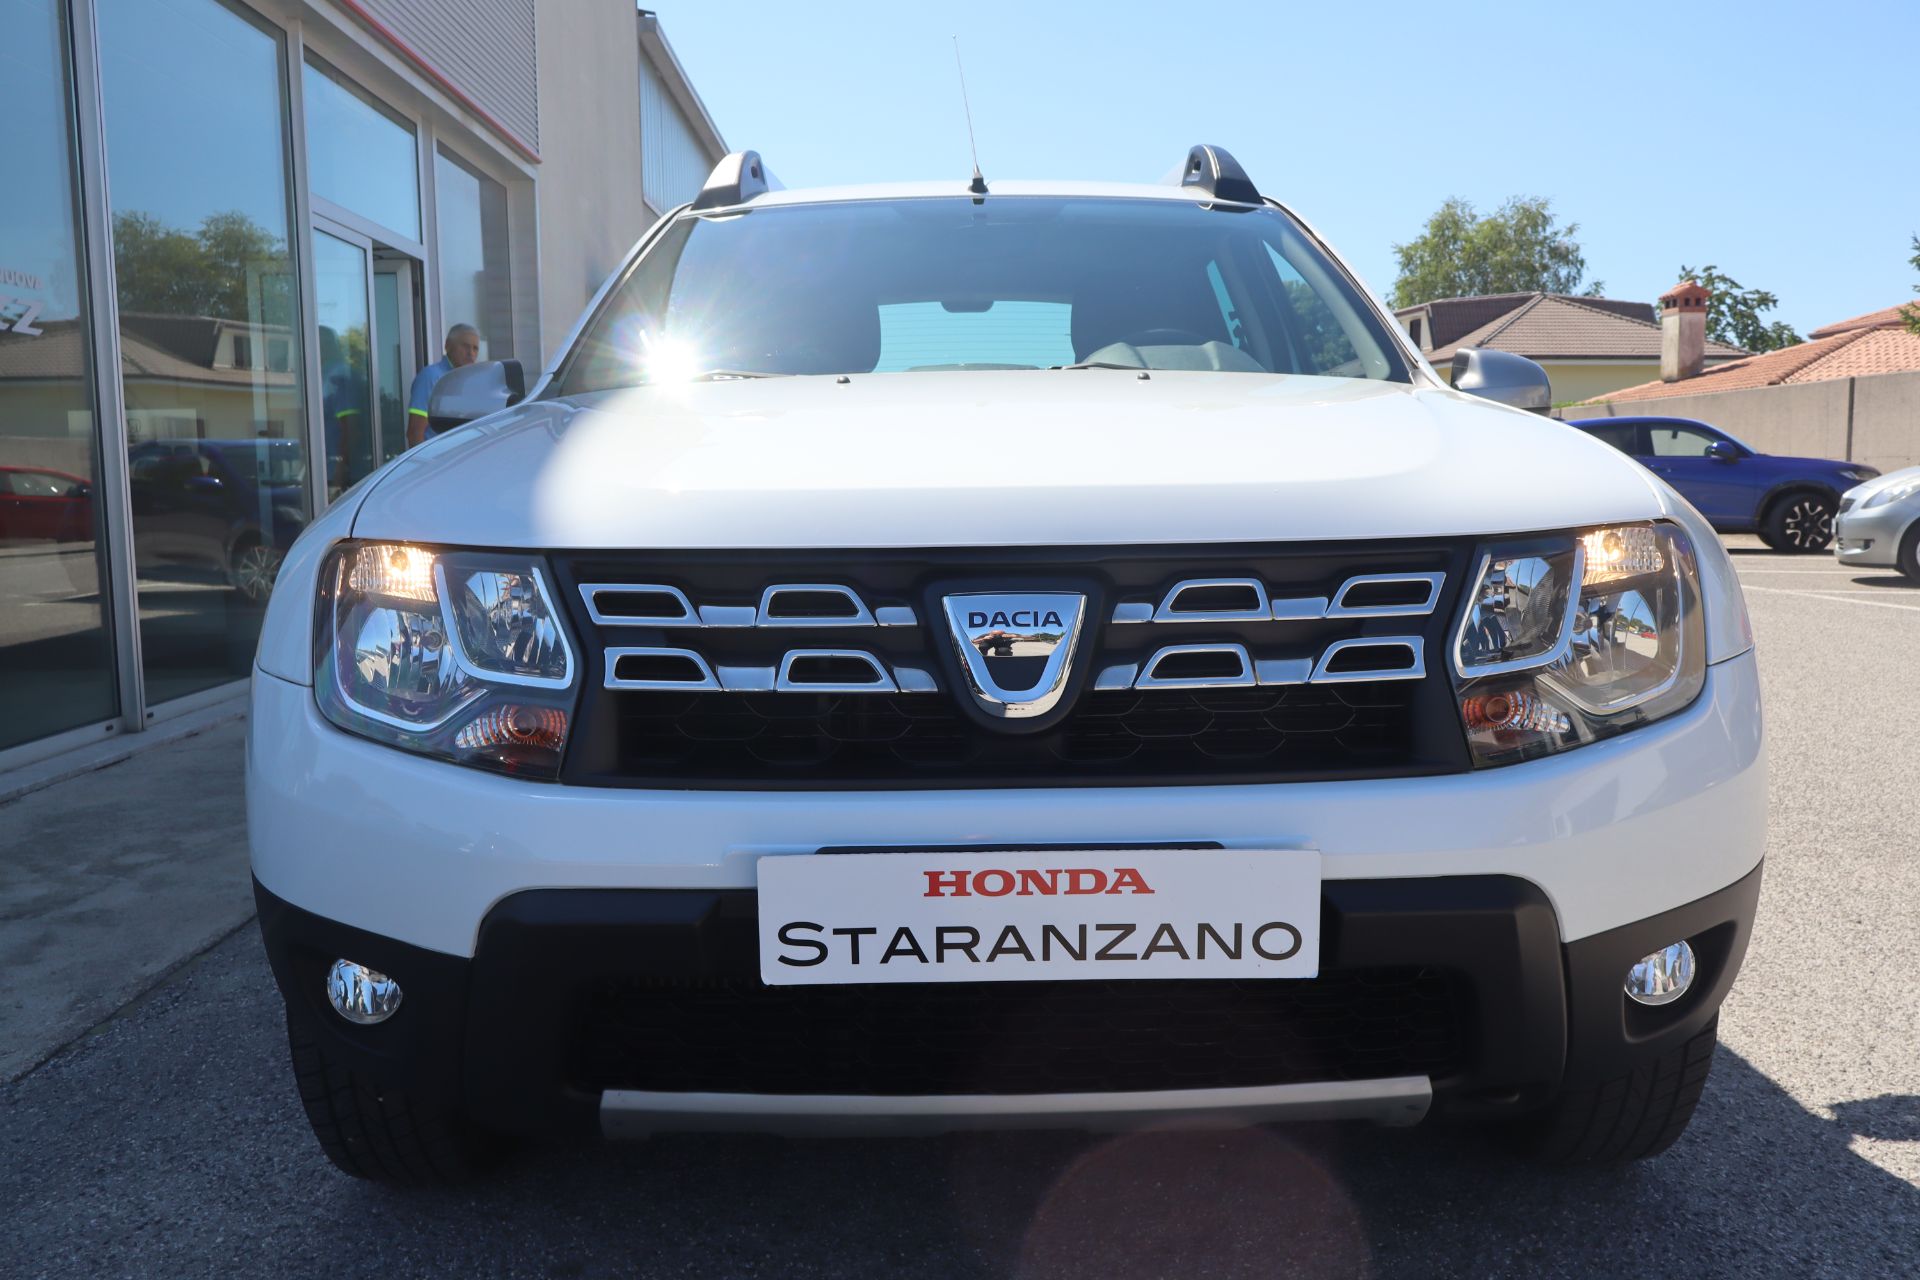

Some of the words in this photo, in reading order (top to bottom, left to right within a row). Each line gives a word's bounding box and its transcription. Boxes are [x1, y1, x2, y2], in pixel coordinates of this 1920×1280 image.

[968, 611, 1063, 628] DACIA
[923, 868, 1155, 897] HONDA
[777, 921, 1303, 967] STARANZANO
